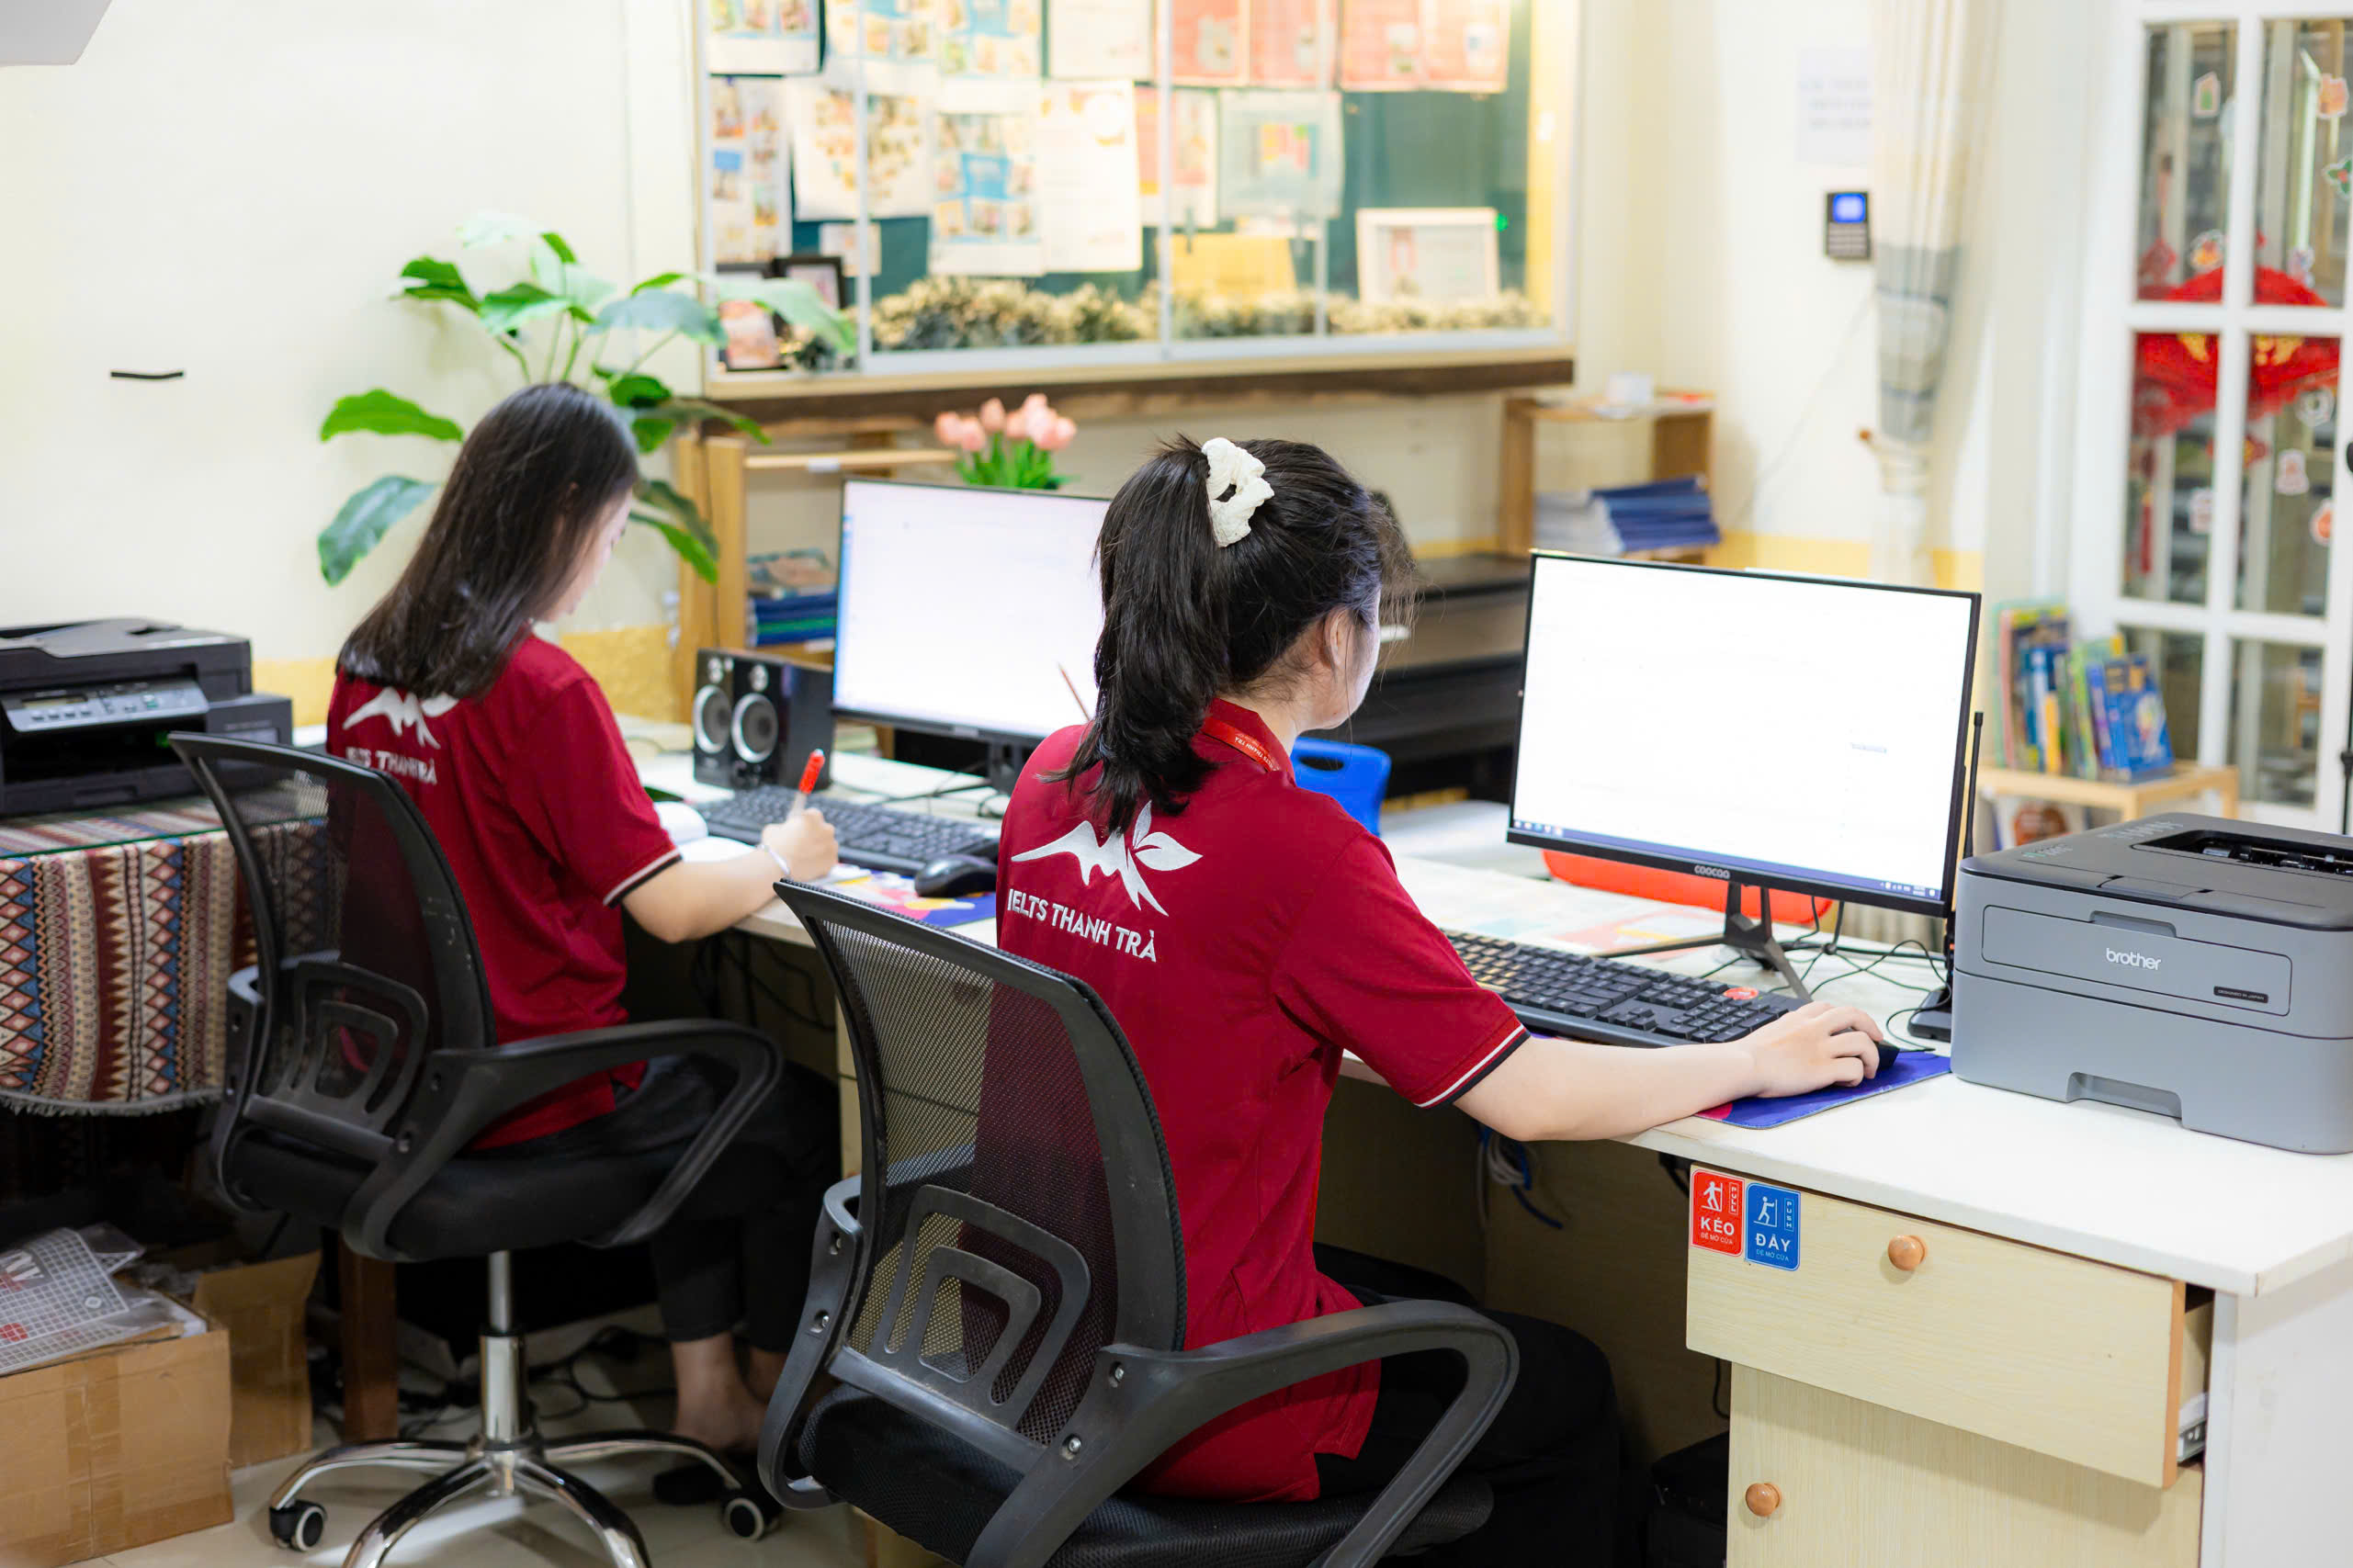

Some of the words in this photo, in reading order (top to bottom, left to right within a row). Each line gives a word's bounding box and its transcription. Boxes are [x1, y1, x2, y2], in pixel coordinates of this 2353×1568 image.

[1007, 888, 1048, 921] IELTS
[1051, 902, 1112, 946] THANH
[1115, 925, 1157, 963] TRÀ
[2106, 947, 2162, 971] brother
[1700, 1216, 1735, 1235] KÉO
